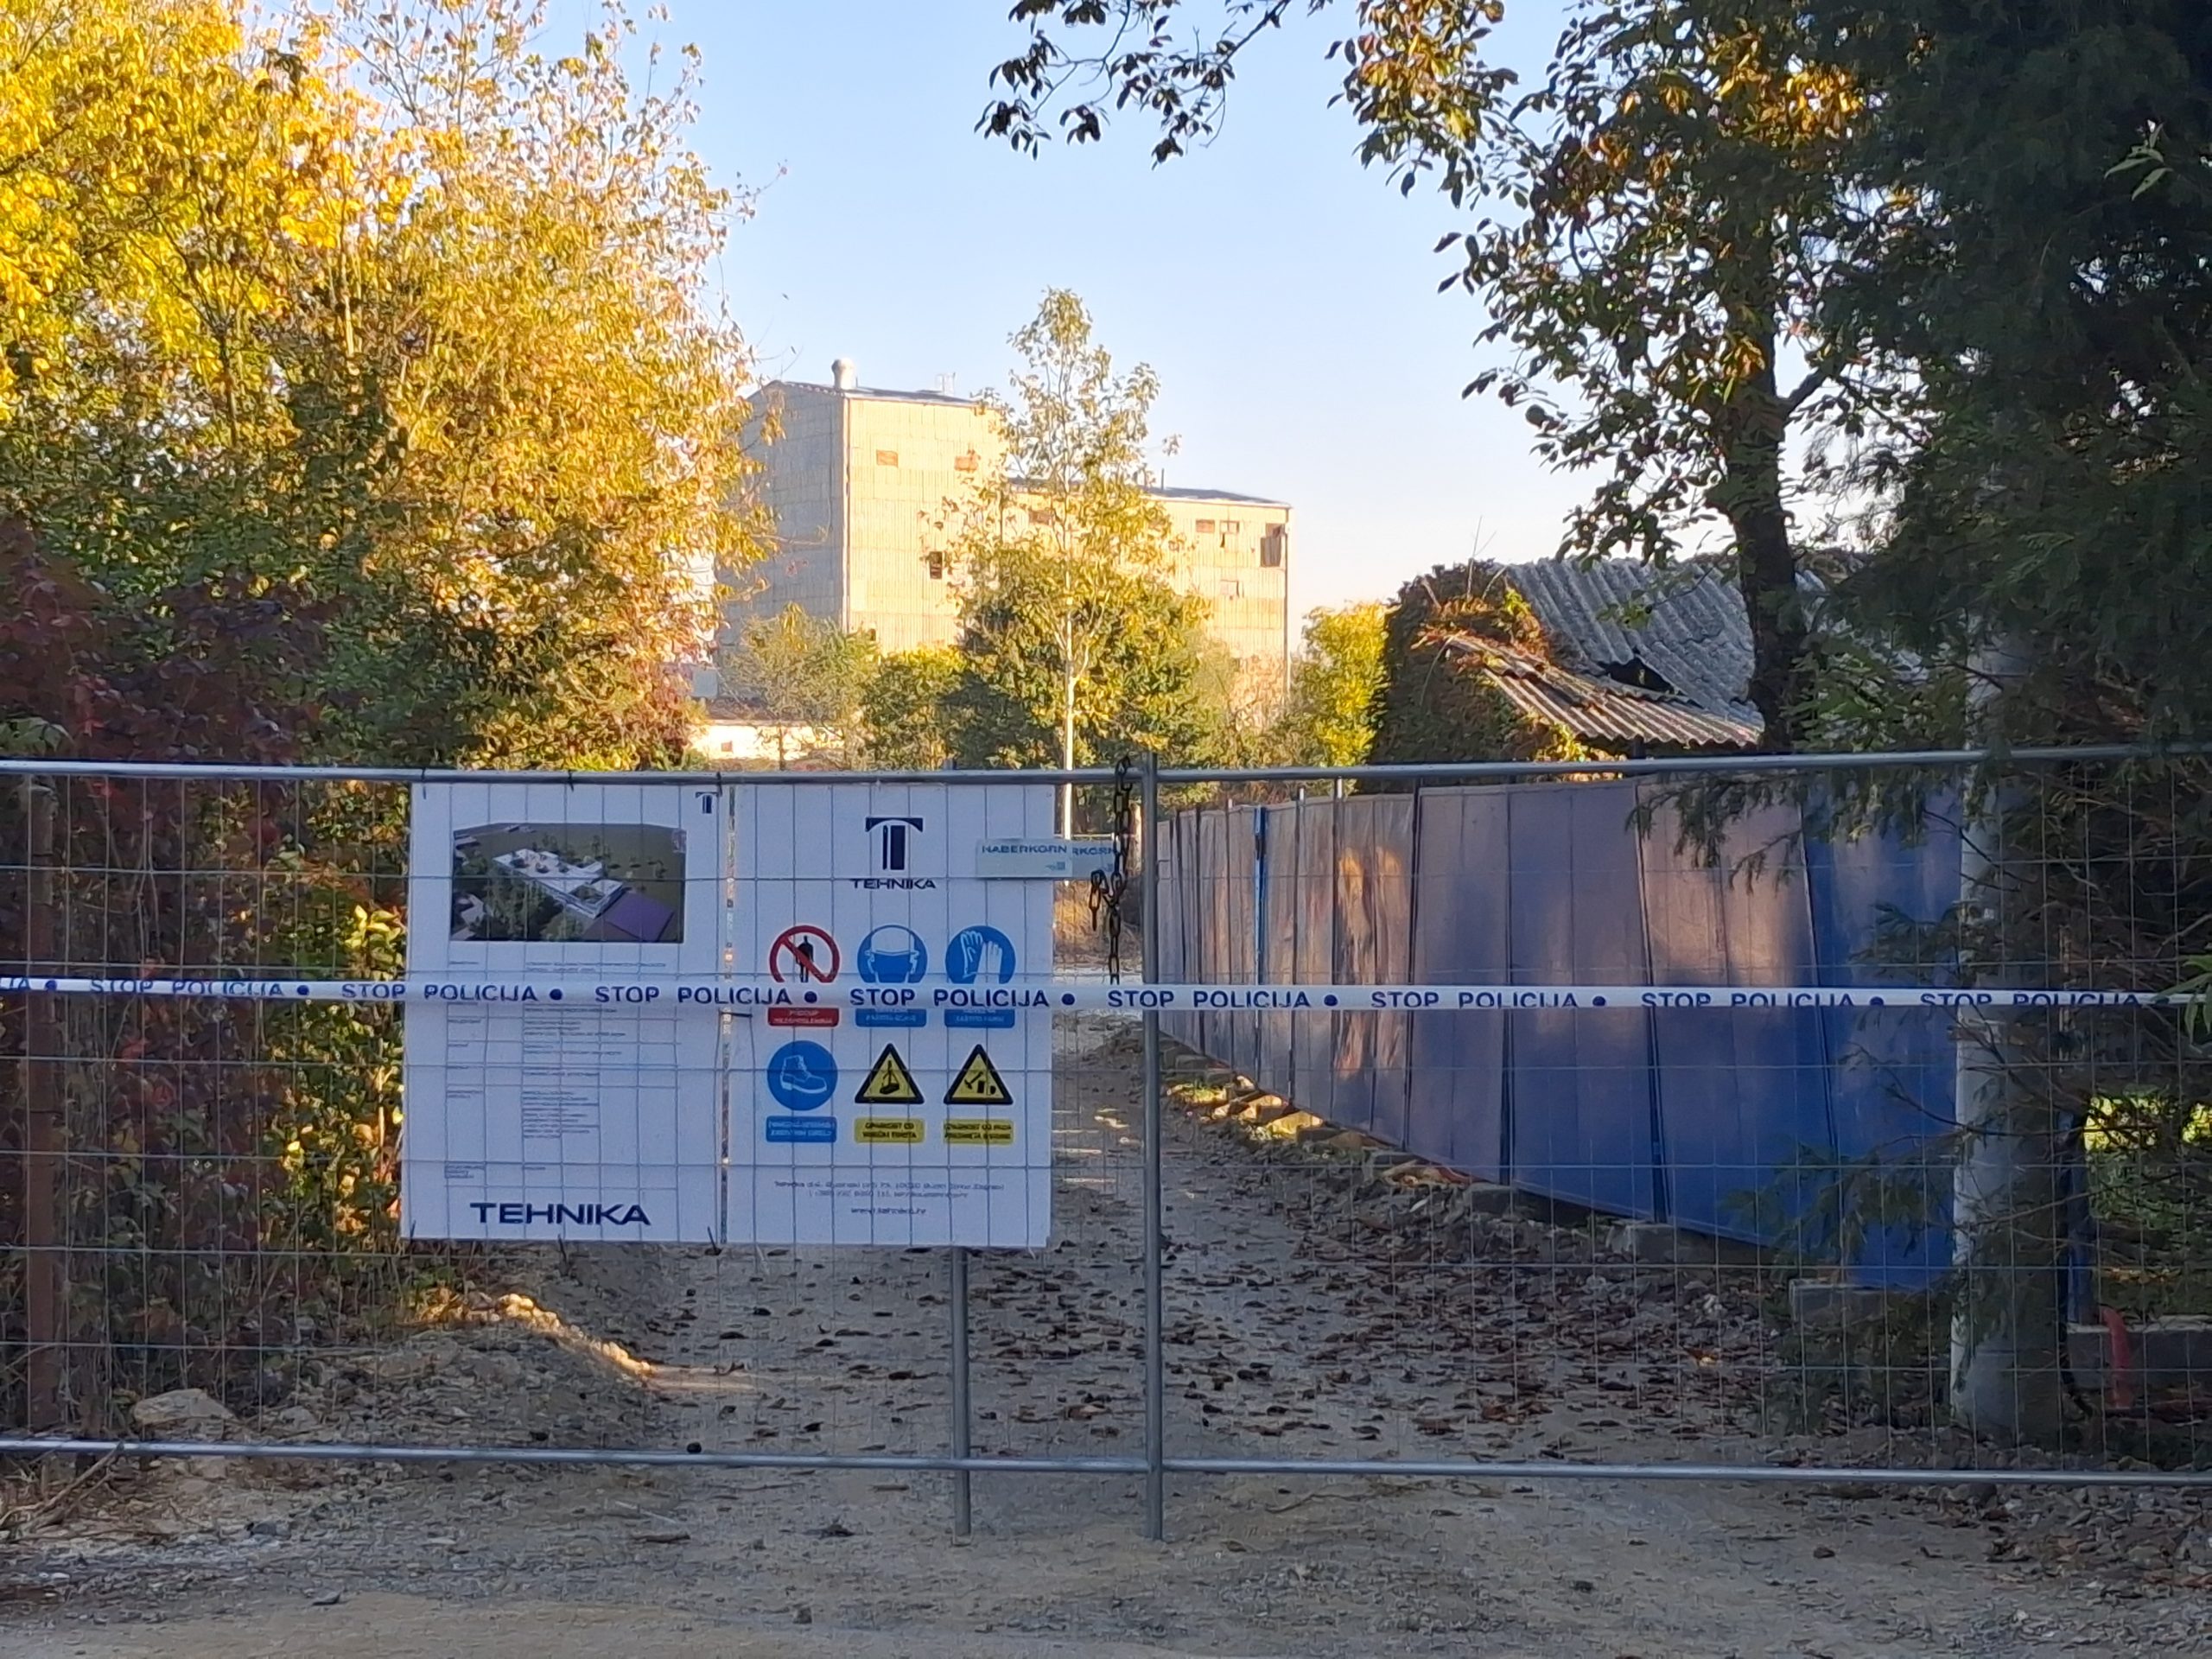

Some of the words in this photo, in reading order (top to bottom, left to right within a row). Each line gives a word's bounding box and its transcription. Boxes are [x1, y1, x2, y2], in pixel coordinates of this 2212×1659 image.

[851, 878, 936, 890] TEHNIKA
[90, 979, 154, 993] STOP
[341, 983, 406, 999] STOP
[424, 984, 539, 1002] POLICIJA
[594, 986, 659, 1003] STOP
[677, 987, 792, 1005] POLICIJA
[849, 988, 916, 1007] STOP
[933, 989, 1050, 1008] POLICIJA
[1107, 990, 1175, 1007] STOP
[1193, 990, 1311, 1008] POLICIJA
[1370, 991, 1440, 1008] STOP
[1459, 991, 1579, 1009] POLICIJA
[1641, 992, 1712, 1007] STOP
[1921, 993, 1993, 1007] STOP
[470, 1202, 652, 1226] TEHNIKA
